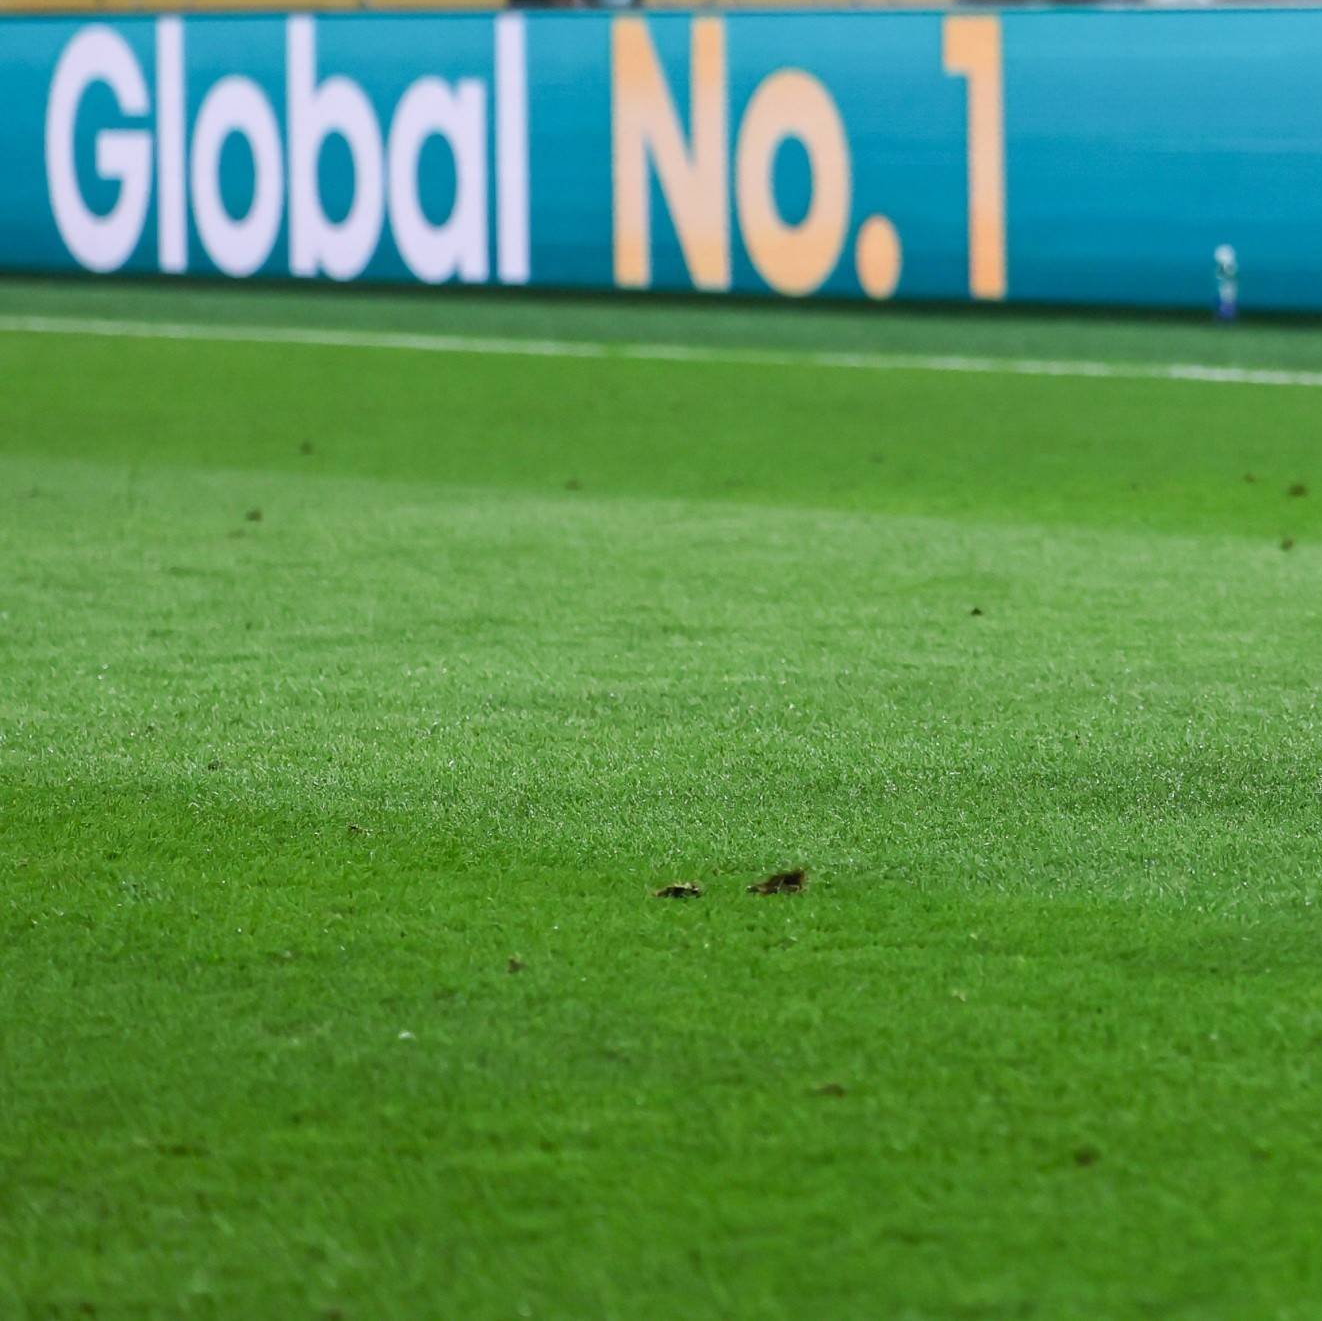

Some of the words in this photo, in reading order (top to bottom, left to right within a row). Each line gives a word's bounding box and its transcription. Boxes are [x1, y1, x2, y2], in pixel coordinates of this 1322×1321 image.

[45, 17, 530, 285] Global
[610, 17, 903, 300] No.
[943, 17, 1007, 301] 1
